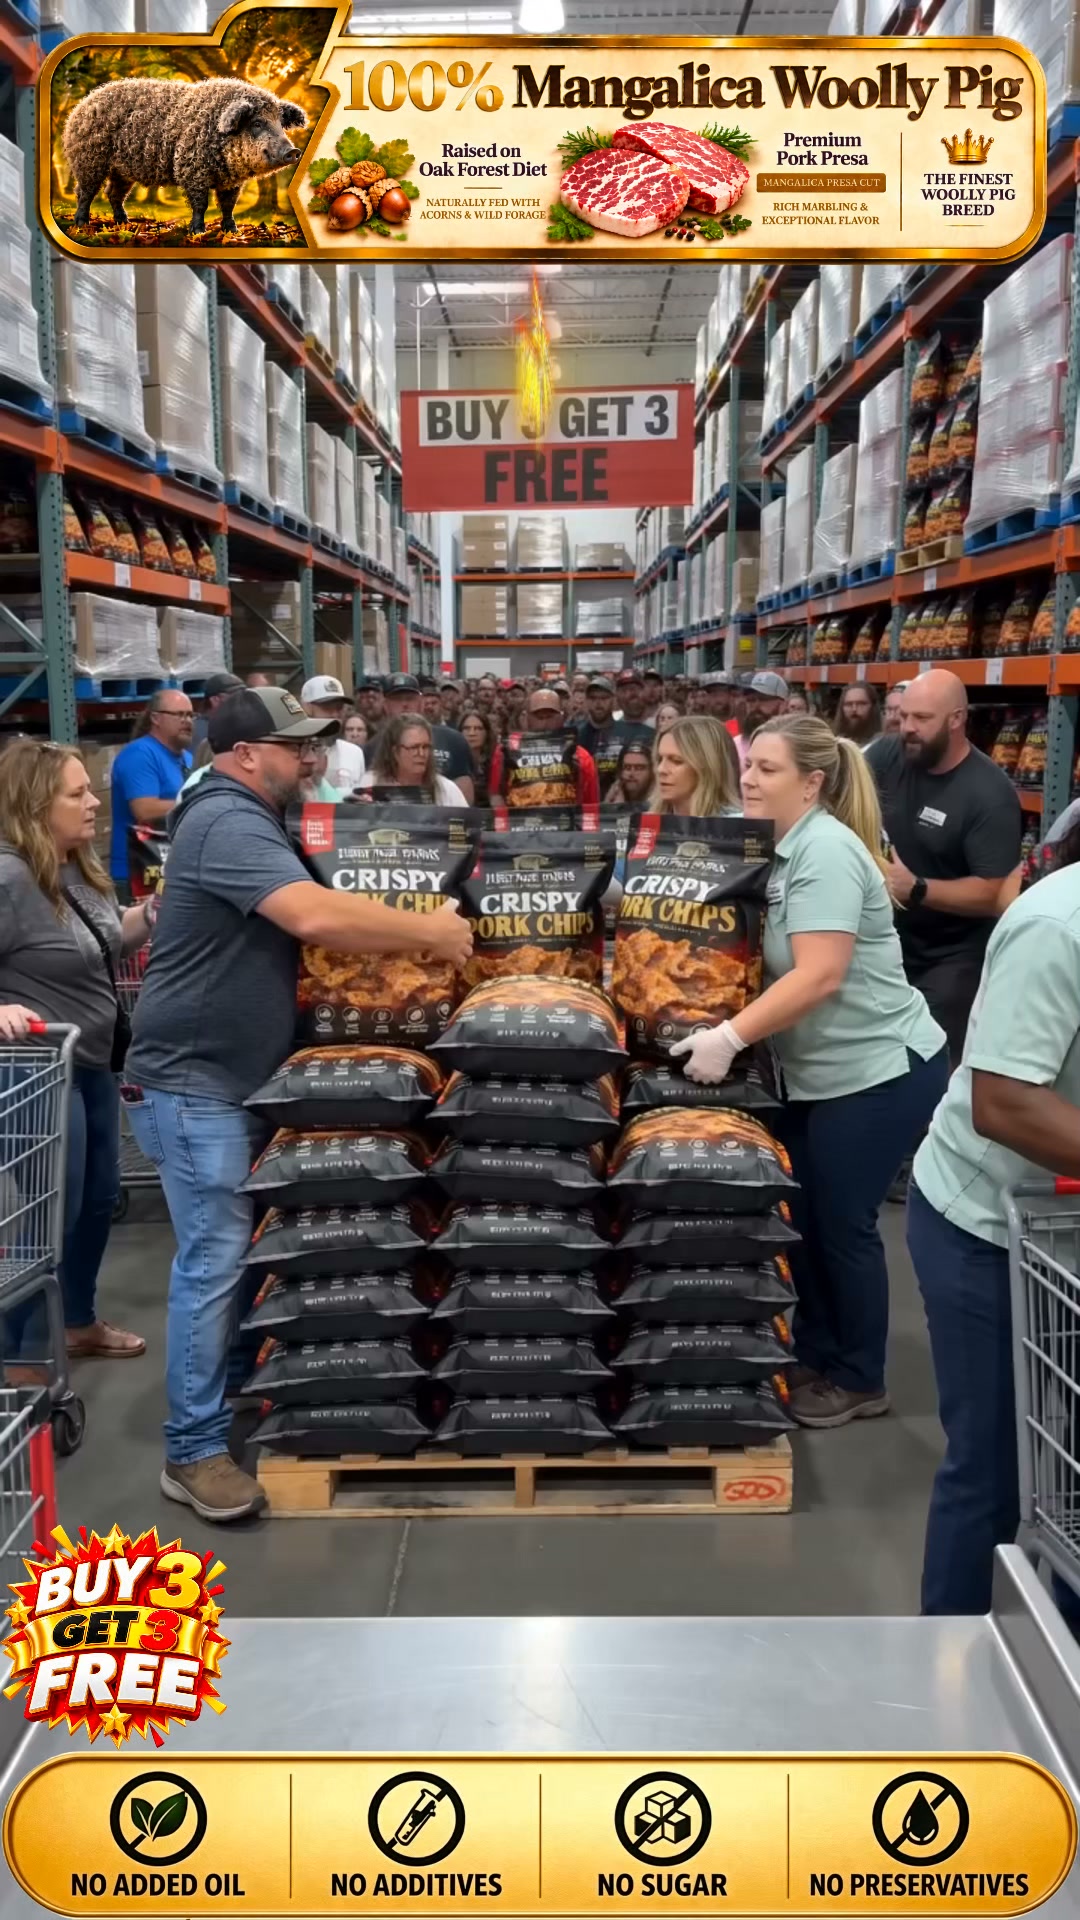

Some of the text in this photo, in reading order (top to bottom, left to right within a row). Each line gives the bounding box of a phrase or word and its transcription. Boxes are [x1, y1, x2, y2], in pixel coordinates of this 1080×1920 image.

[427, 399, 510, 441] BUY
[559, 396, 633, 438] GET
[644, 394, 669, 436] 3
[484, 447, 608, 503] FREE
[332, 867, 447, 892] CRISPY
[624, 874, 720, 904] CRISPY
[480, 891, 582, 914] CRISPY
[659, 897, 736, 932] CHIPS
[537, 913, 594, 936] CHIPS
